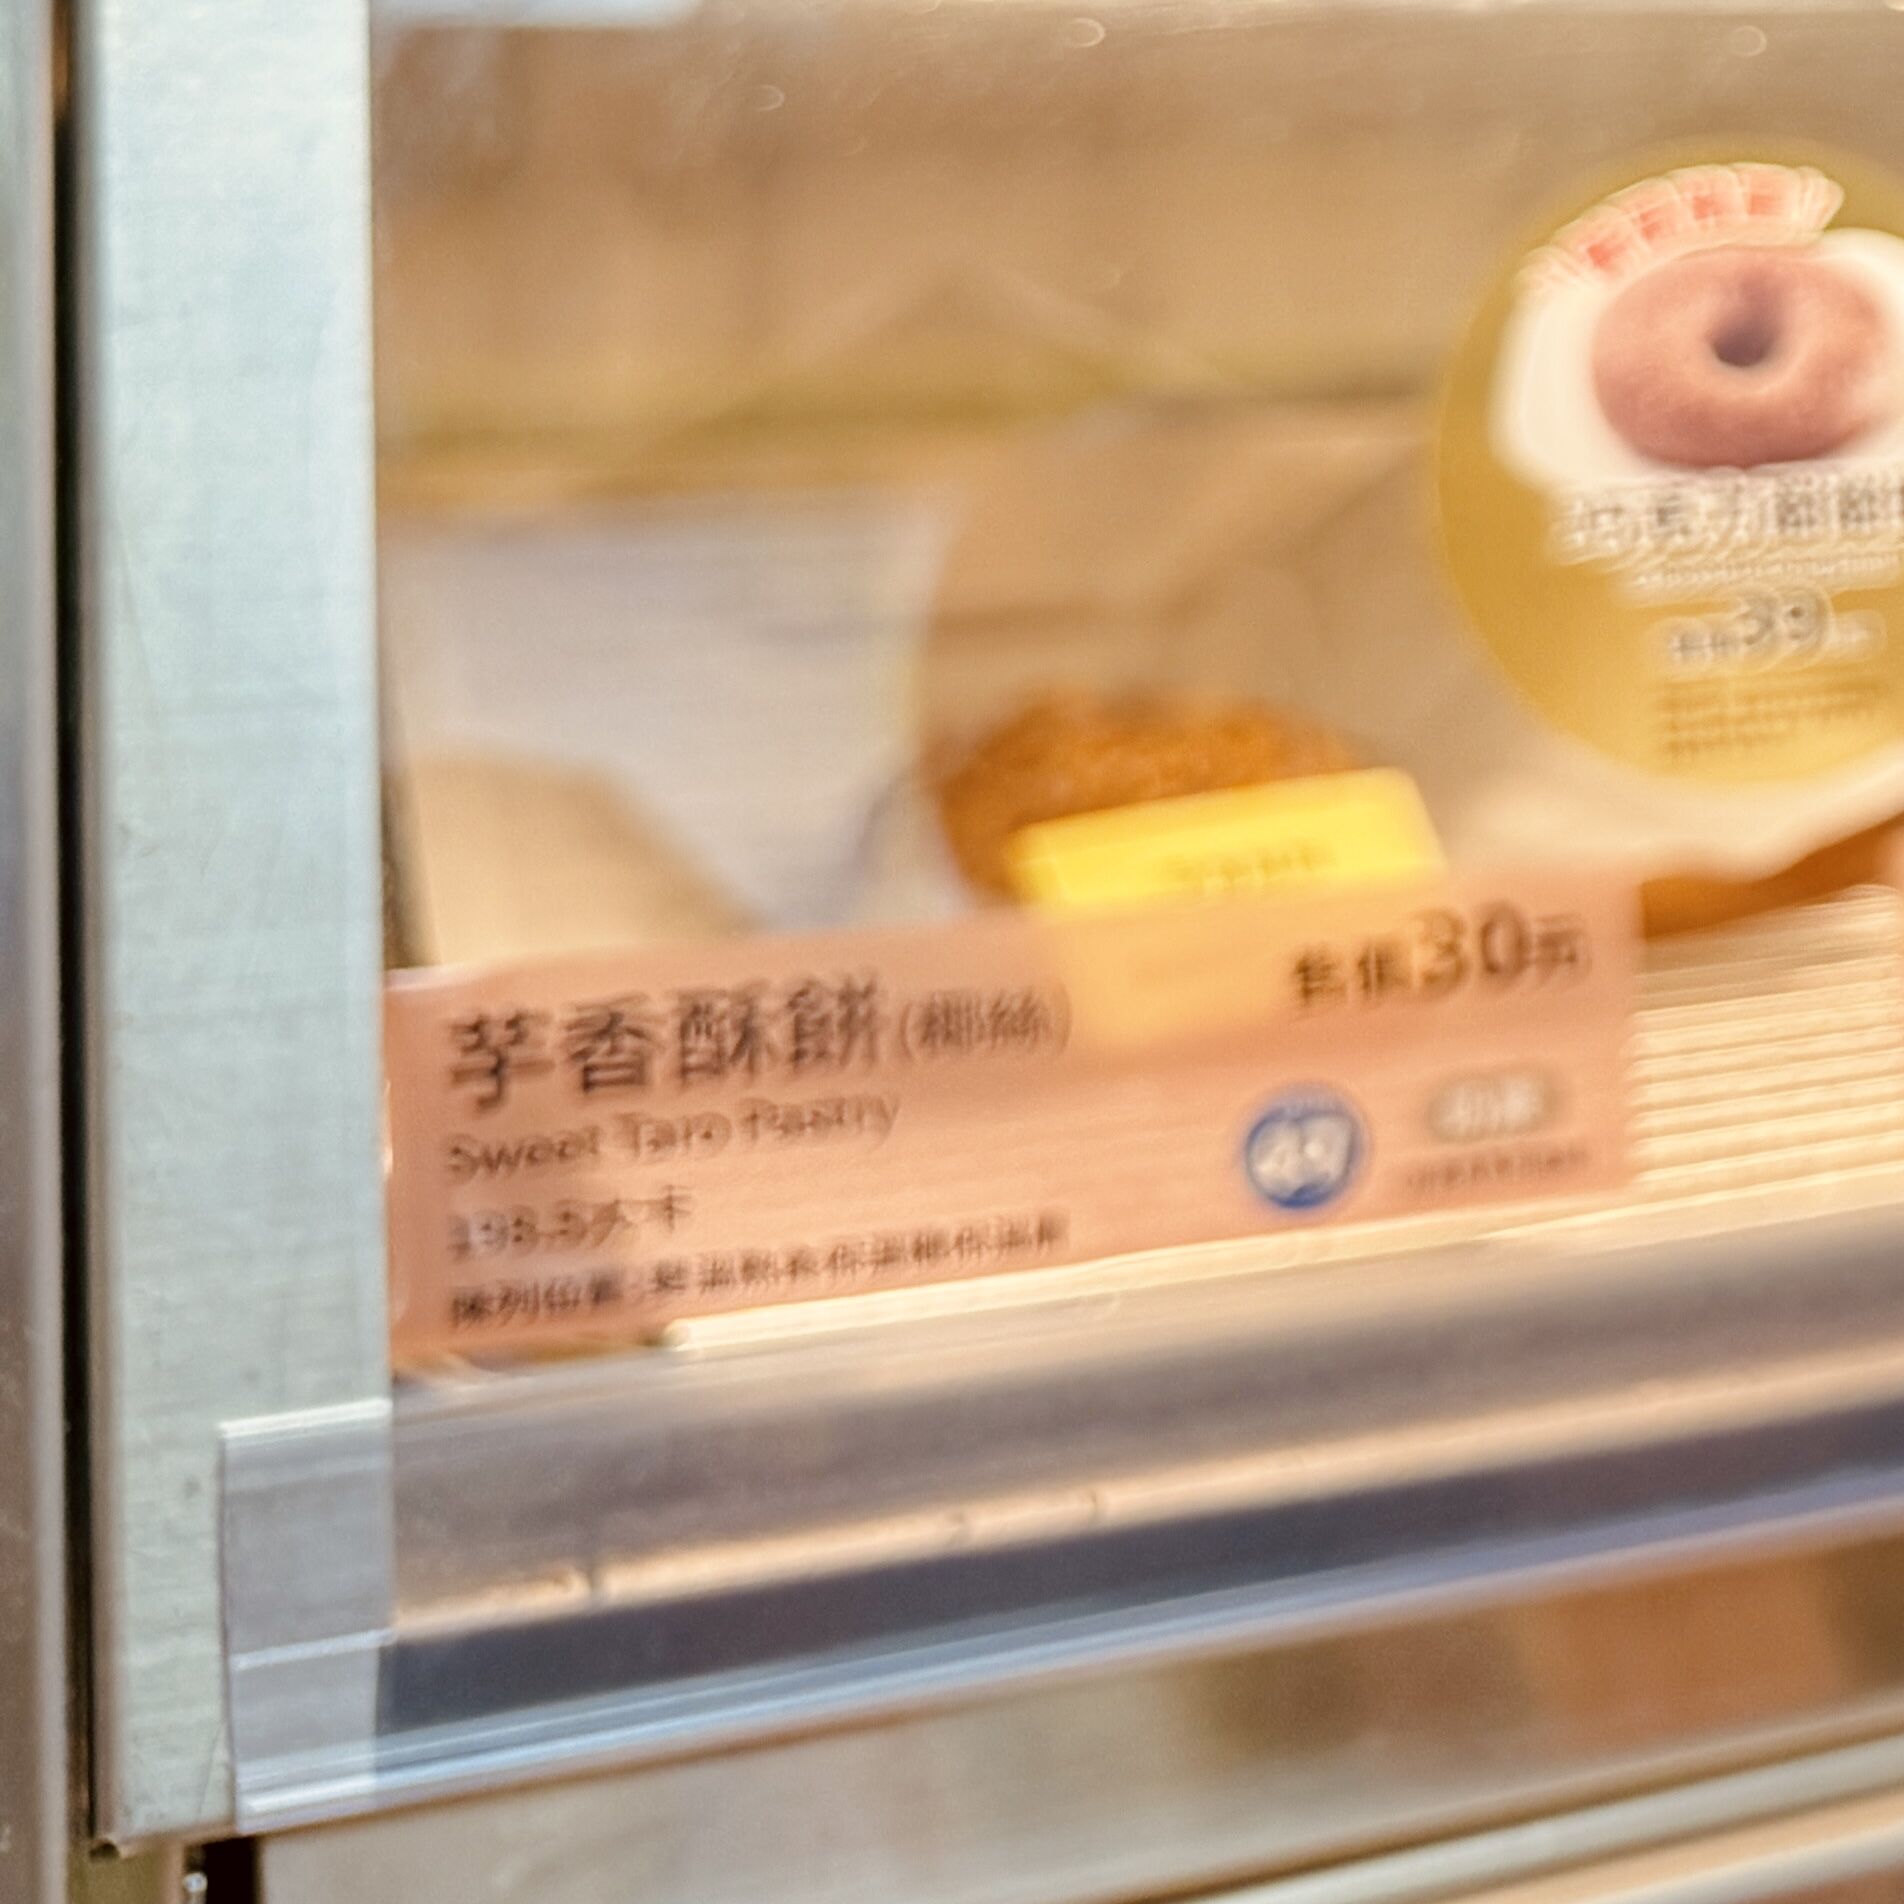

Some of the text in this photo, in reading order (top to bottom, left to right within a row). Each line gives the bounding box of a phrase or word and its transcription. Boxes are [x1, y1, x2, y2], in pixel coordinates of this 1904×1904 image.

[446, 1096, 900, 1182] Sweet Taro Pastry
